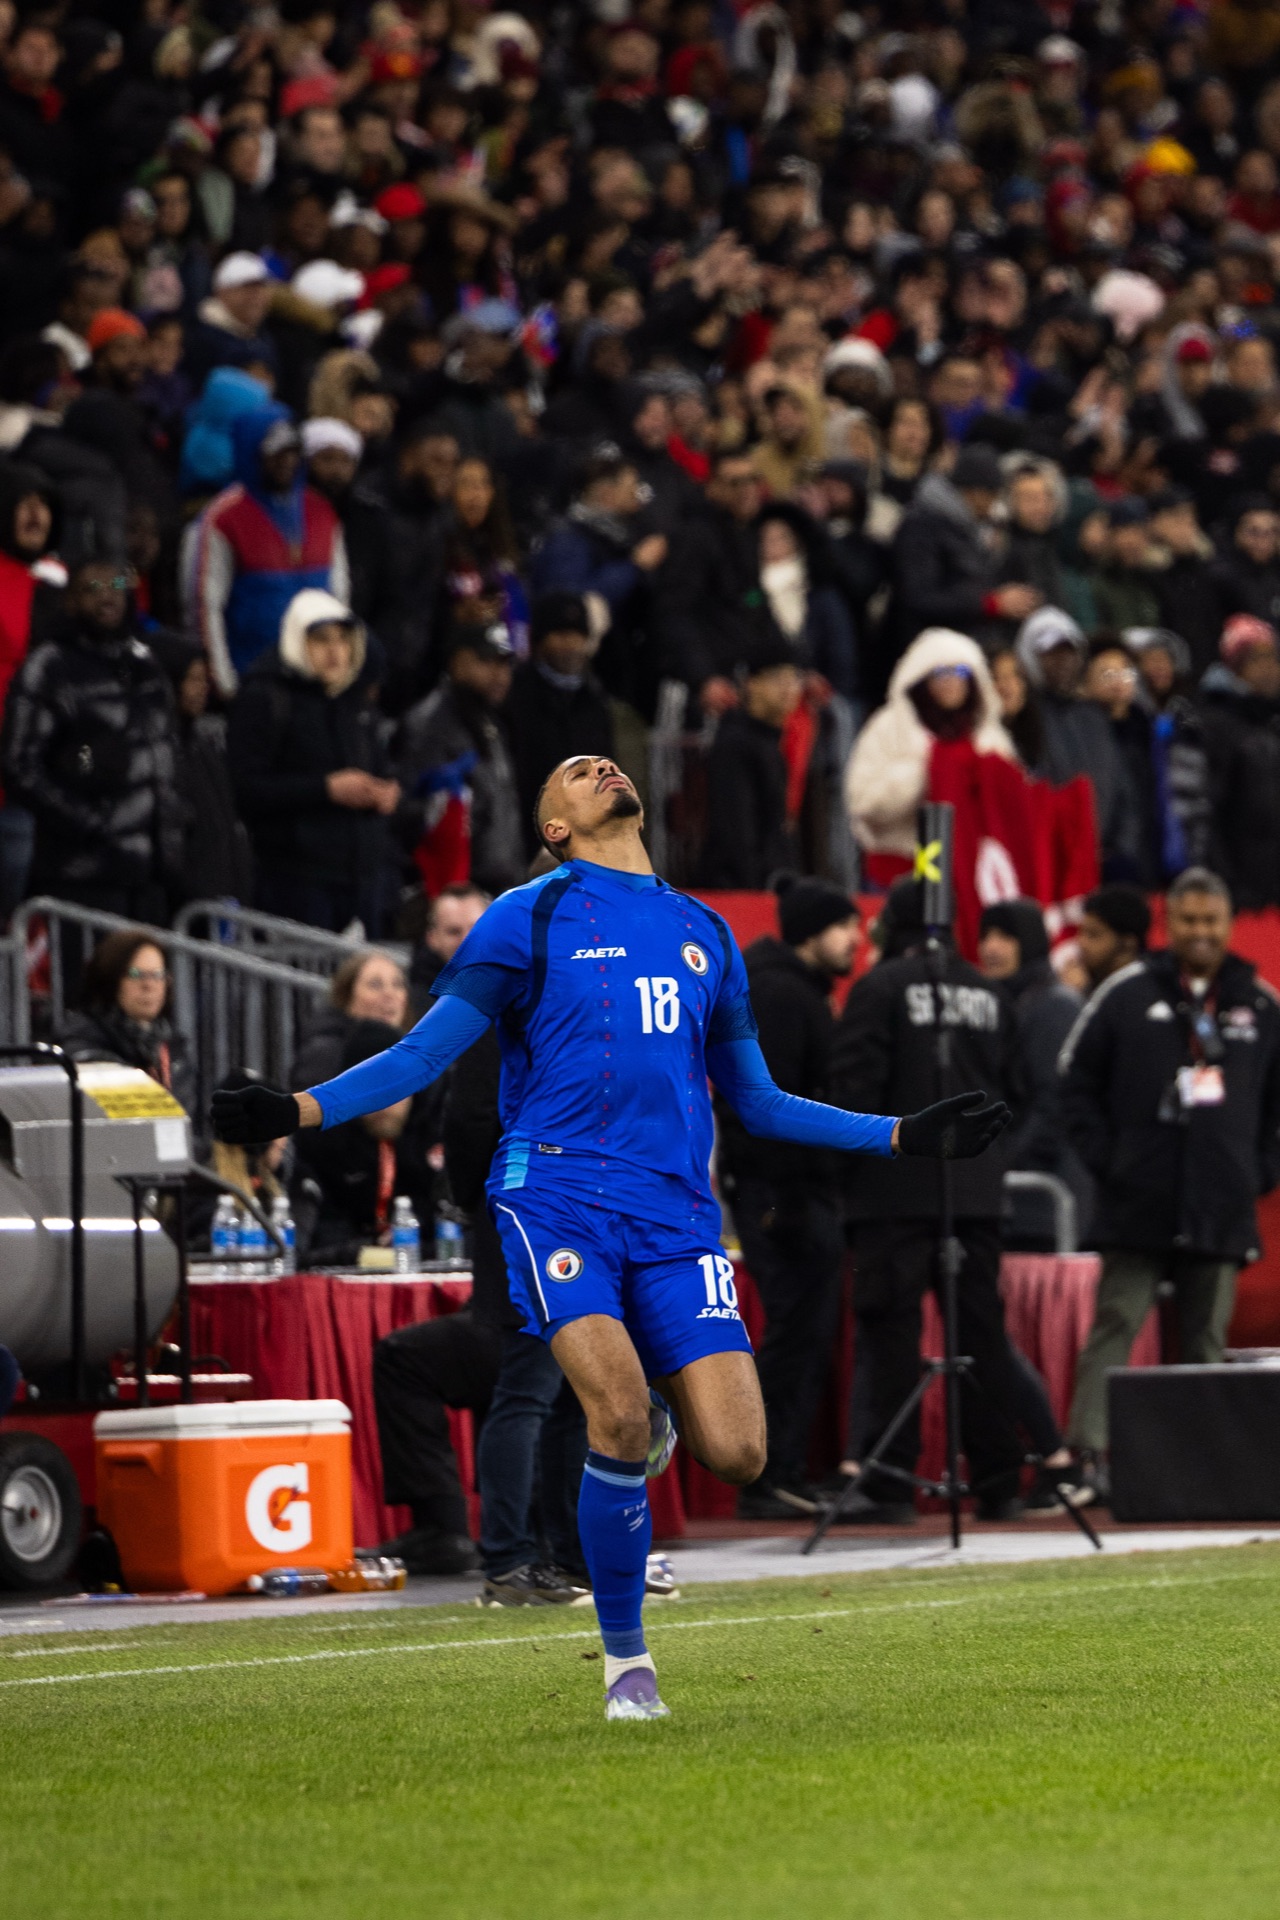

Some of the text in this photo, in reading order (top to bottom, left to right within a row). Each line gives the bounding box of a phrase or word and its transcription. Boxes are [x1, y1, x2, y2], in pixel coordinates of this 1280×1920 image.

[570, 947, 627, 959] SAETA
[634, 977, 680, 1034] 18
[697, 1254, 738, 1309] 18
[245, 1462, 311, 1553] G
